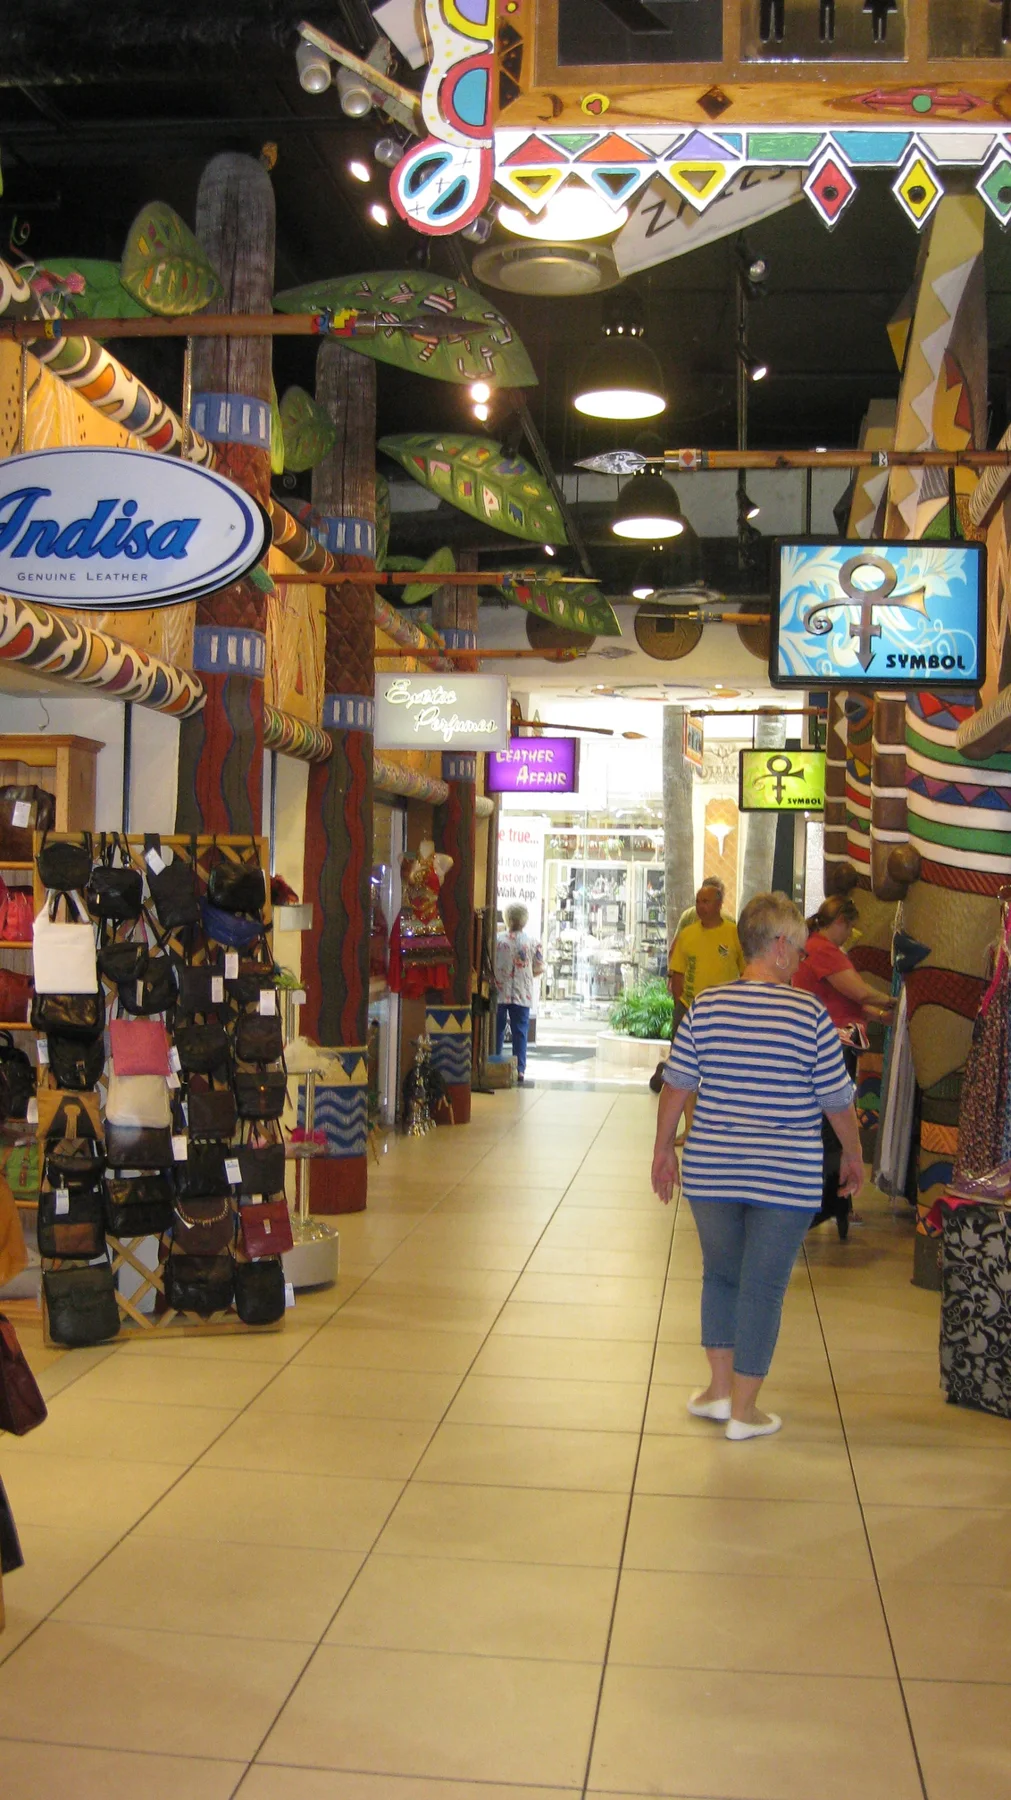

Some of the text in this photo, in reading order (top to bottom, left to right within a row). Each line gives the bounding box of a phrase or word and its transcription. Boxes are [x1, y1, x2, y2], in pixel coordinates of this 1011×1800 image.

[0, 486, 202, 560] Indisa
[17, 572, 149, 582] GENUINE LEATHER
[885, 653, 966, 671] SYMBOL
[413, 705, 498, 743] Perfumes
[515, 763, 568, 786] AFFAIR
[787, 797, 822, 806] SYMBOL
[512, 857, 520, 867] to
